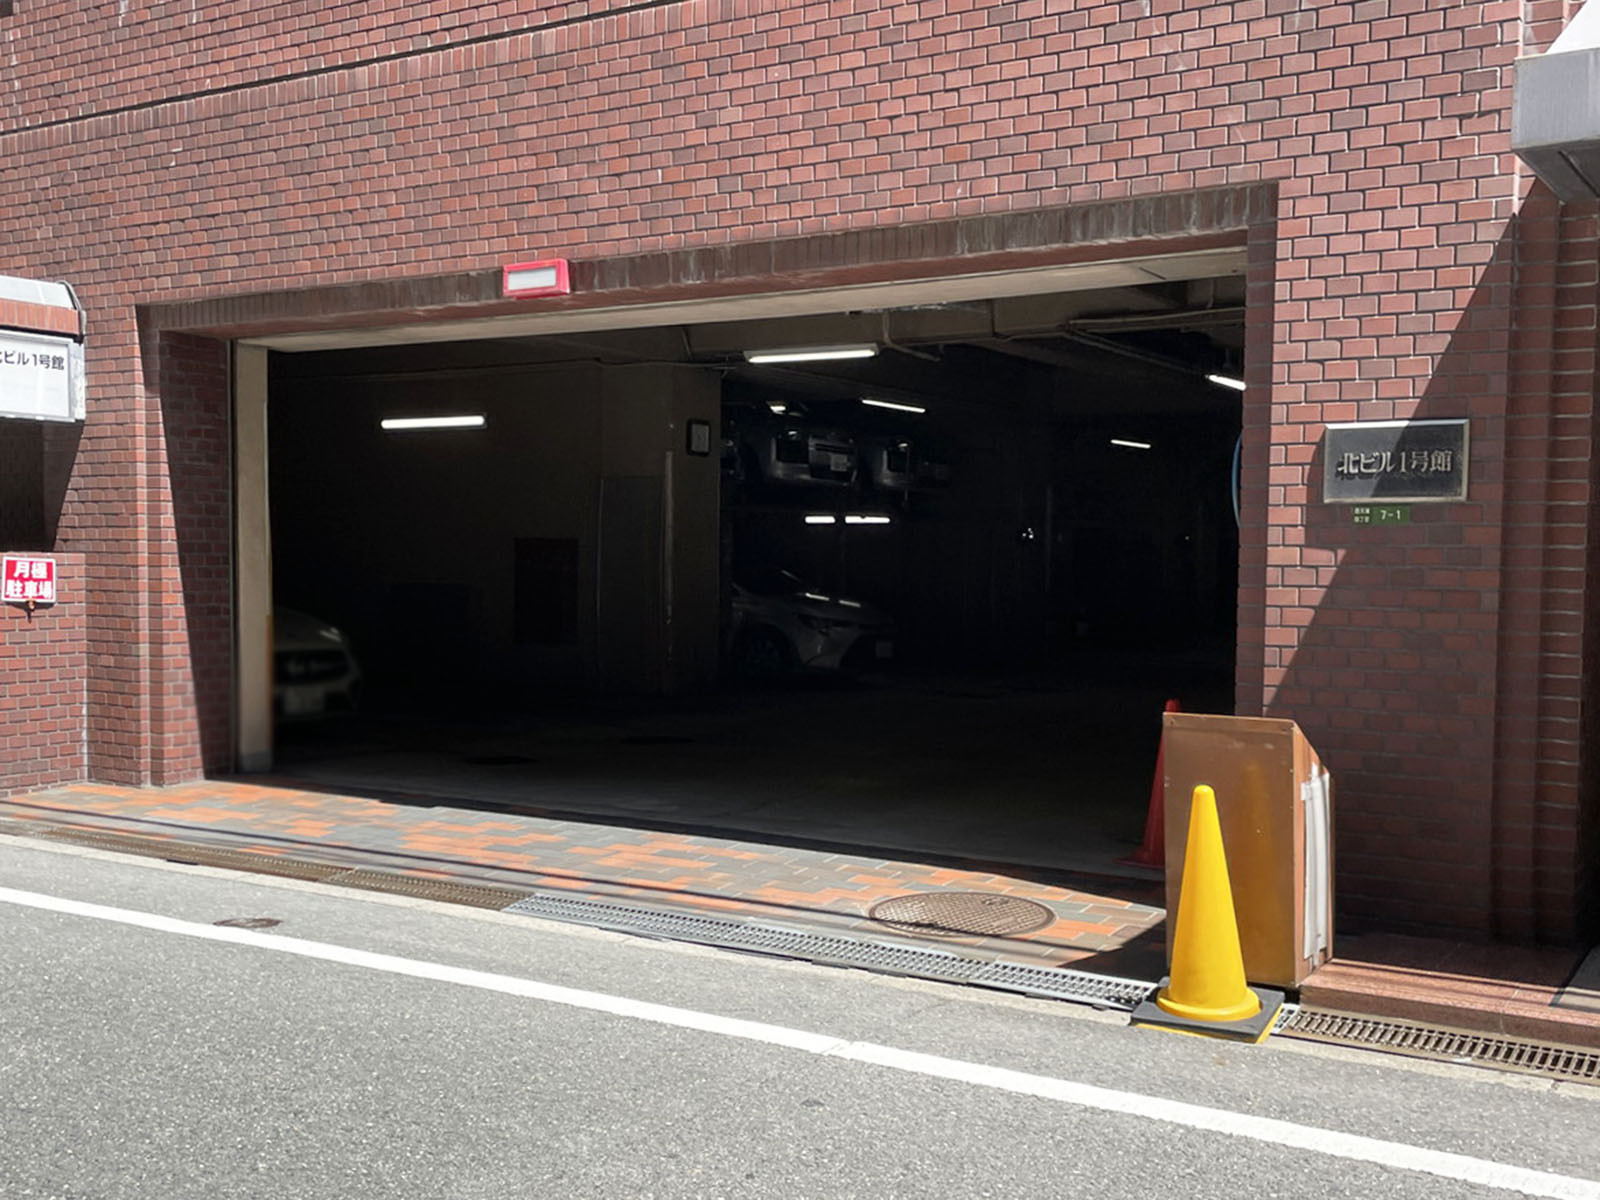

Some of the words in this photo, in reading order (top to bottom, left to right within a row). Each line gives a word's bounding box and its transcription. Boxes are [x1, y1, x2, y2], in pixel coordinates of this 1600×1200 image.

[1337, 449, 1453, 475] 北ビル1号館
[1380, 509, 1402, 520] 7-1
[6, 580, 52, 598] 駐車場
